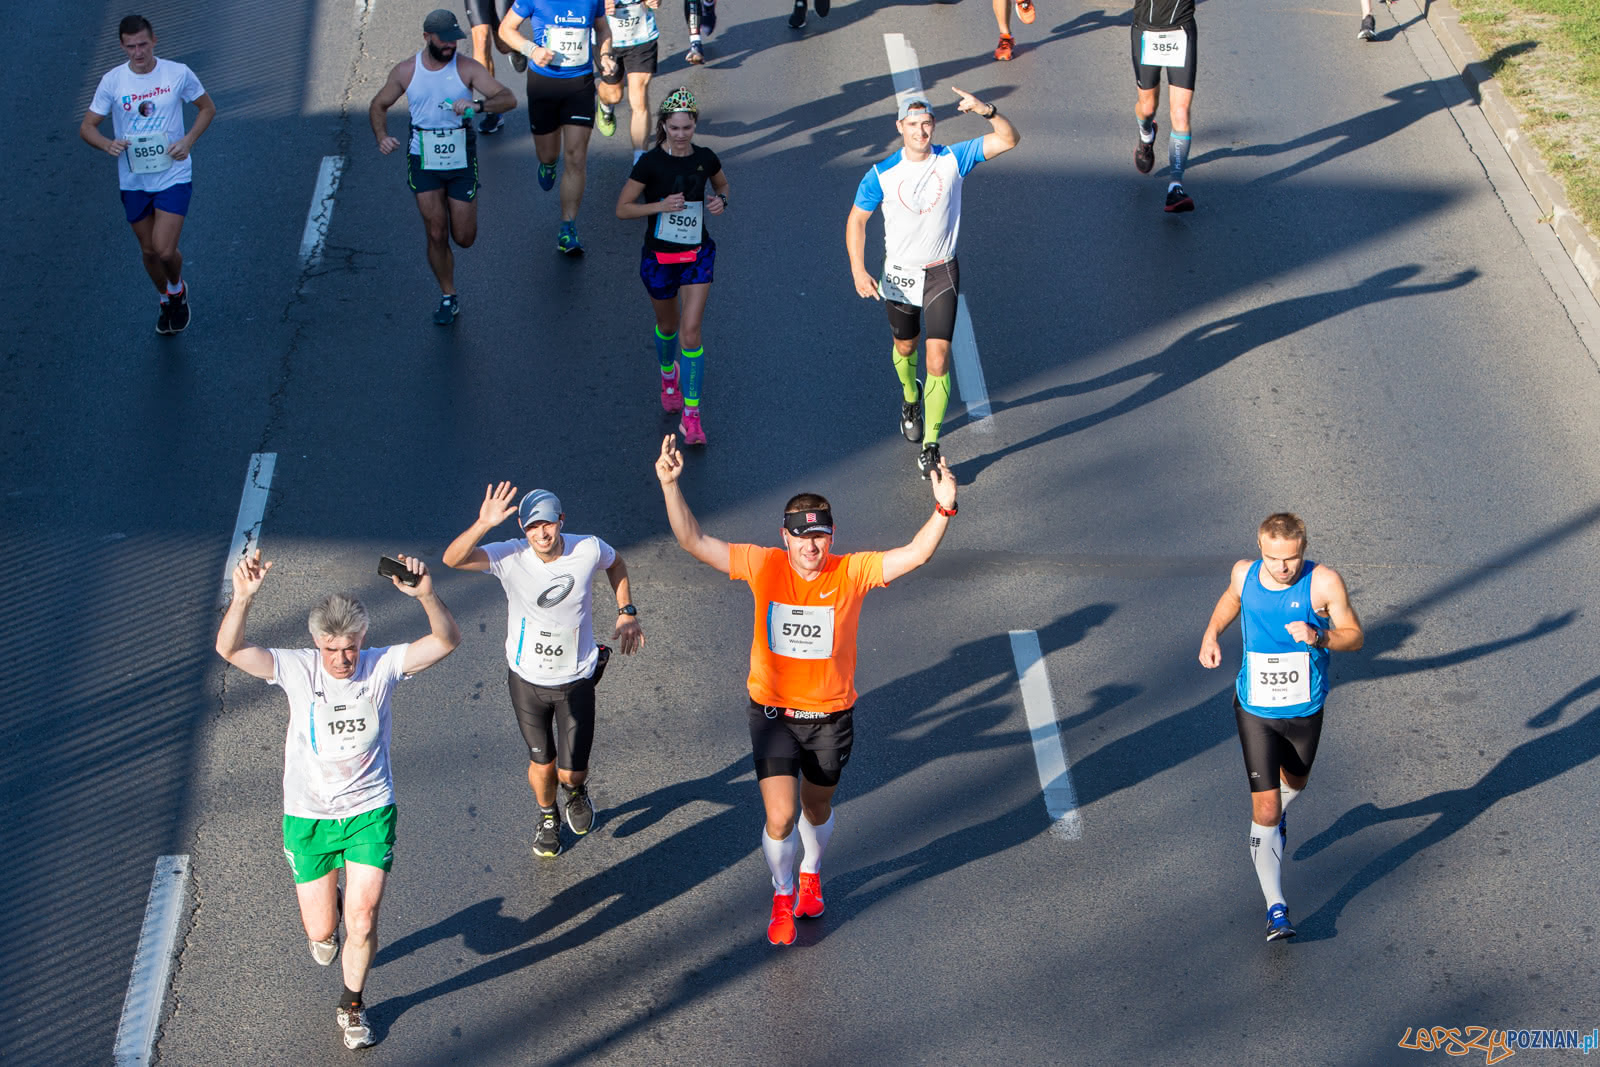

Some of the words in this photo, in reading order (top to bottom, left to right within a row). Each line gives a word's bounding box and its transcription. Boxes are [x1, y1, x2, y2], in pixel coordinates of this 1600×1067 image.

[618, 16, 641, 28] 3572
[559, 41, 583, 51] 3714
[1152, 43, 1179, 52] 3854
[134, 144, 165, 158] 5850
[434, 143, 456, 154] 820
[669, 214, 698, 228] 5506
[886, 273, 916, 288] 5059
[782, 622, 822, 638] 5702
[534, 642, 564, 657] 866
[1260, 670, 1300, 685] 3330
[328, 717, 367, 735] 1933
